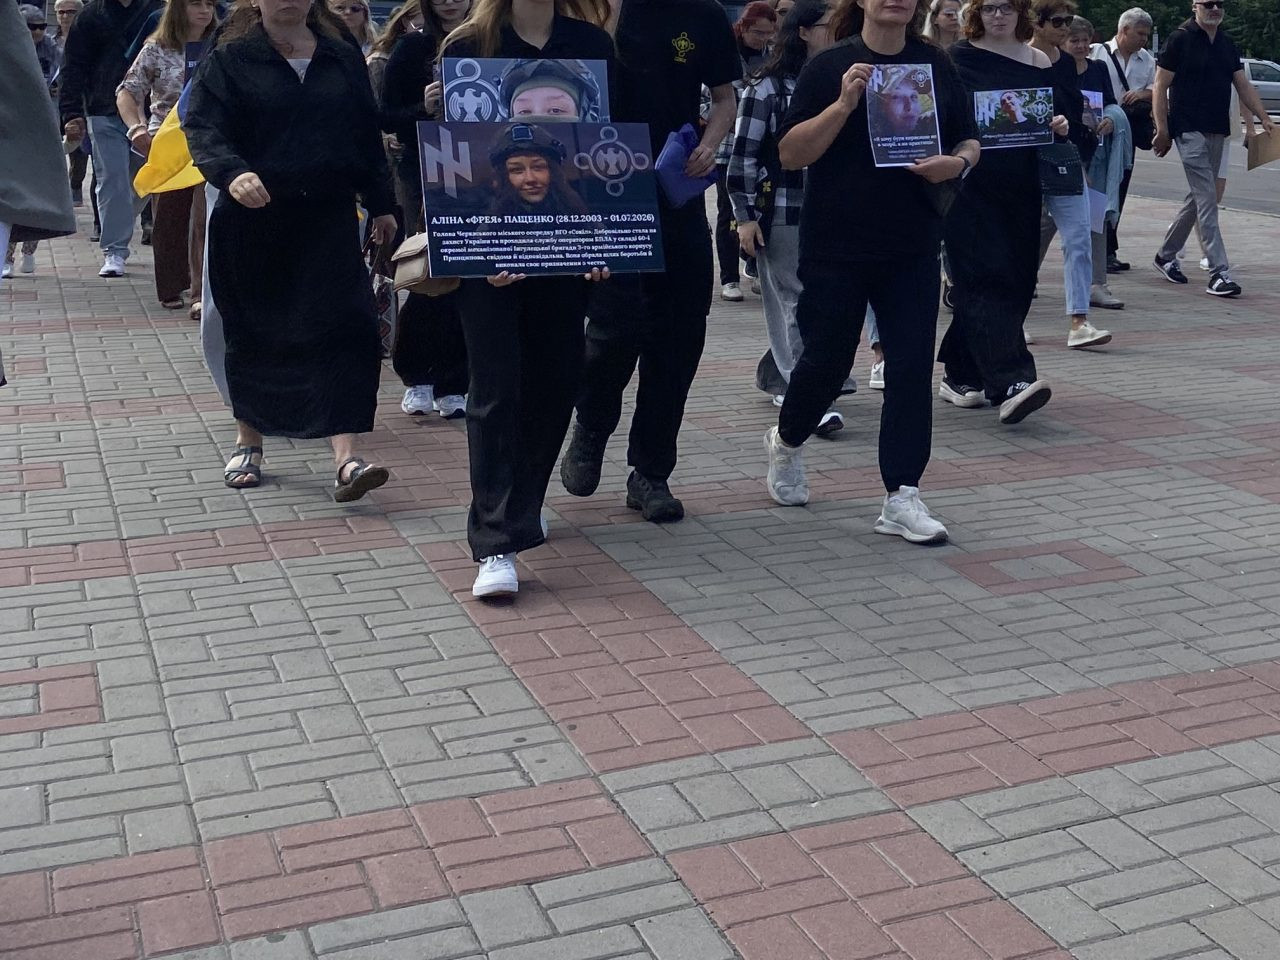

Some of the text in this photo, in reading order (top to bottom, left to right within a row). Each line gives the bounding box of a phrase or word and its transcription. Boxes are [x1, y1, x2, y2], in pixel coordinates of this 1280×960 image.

[466, 216, 502, 224] «ФРЕЯ»
[504, 215, 554, 224] ПАЩЕНКО
[555, 215, 602, 224] (28.12.2003
[610, 214, 655, 223] 01.07.2026)
